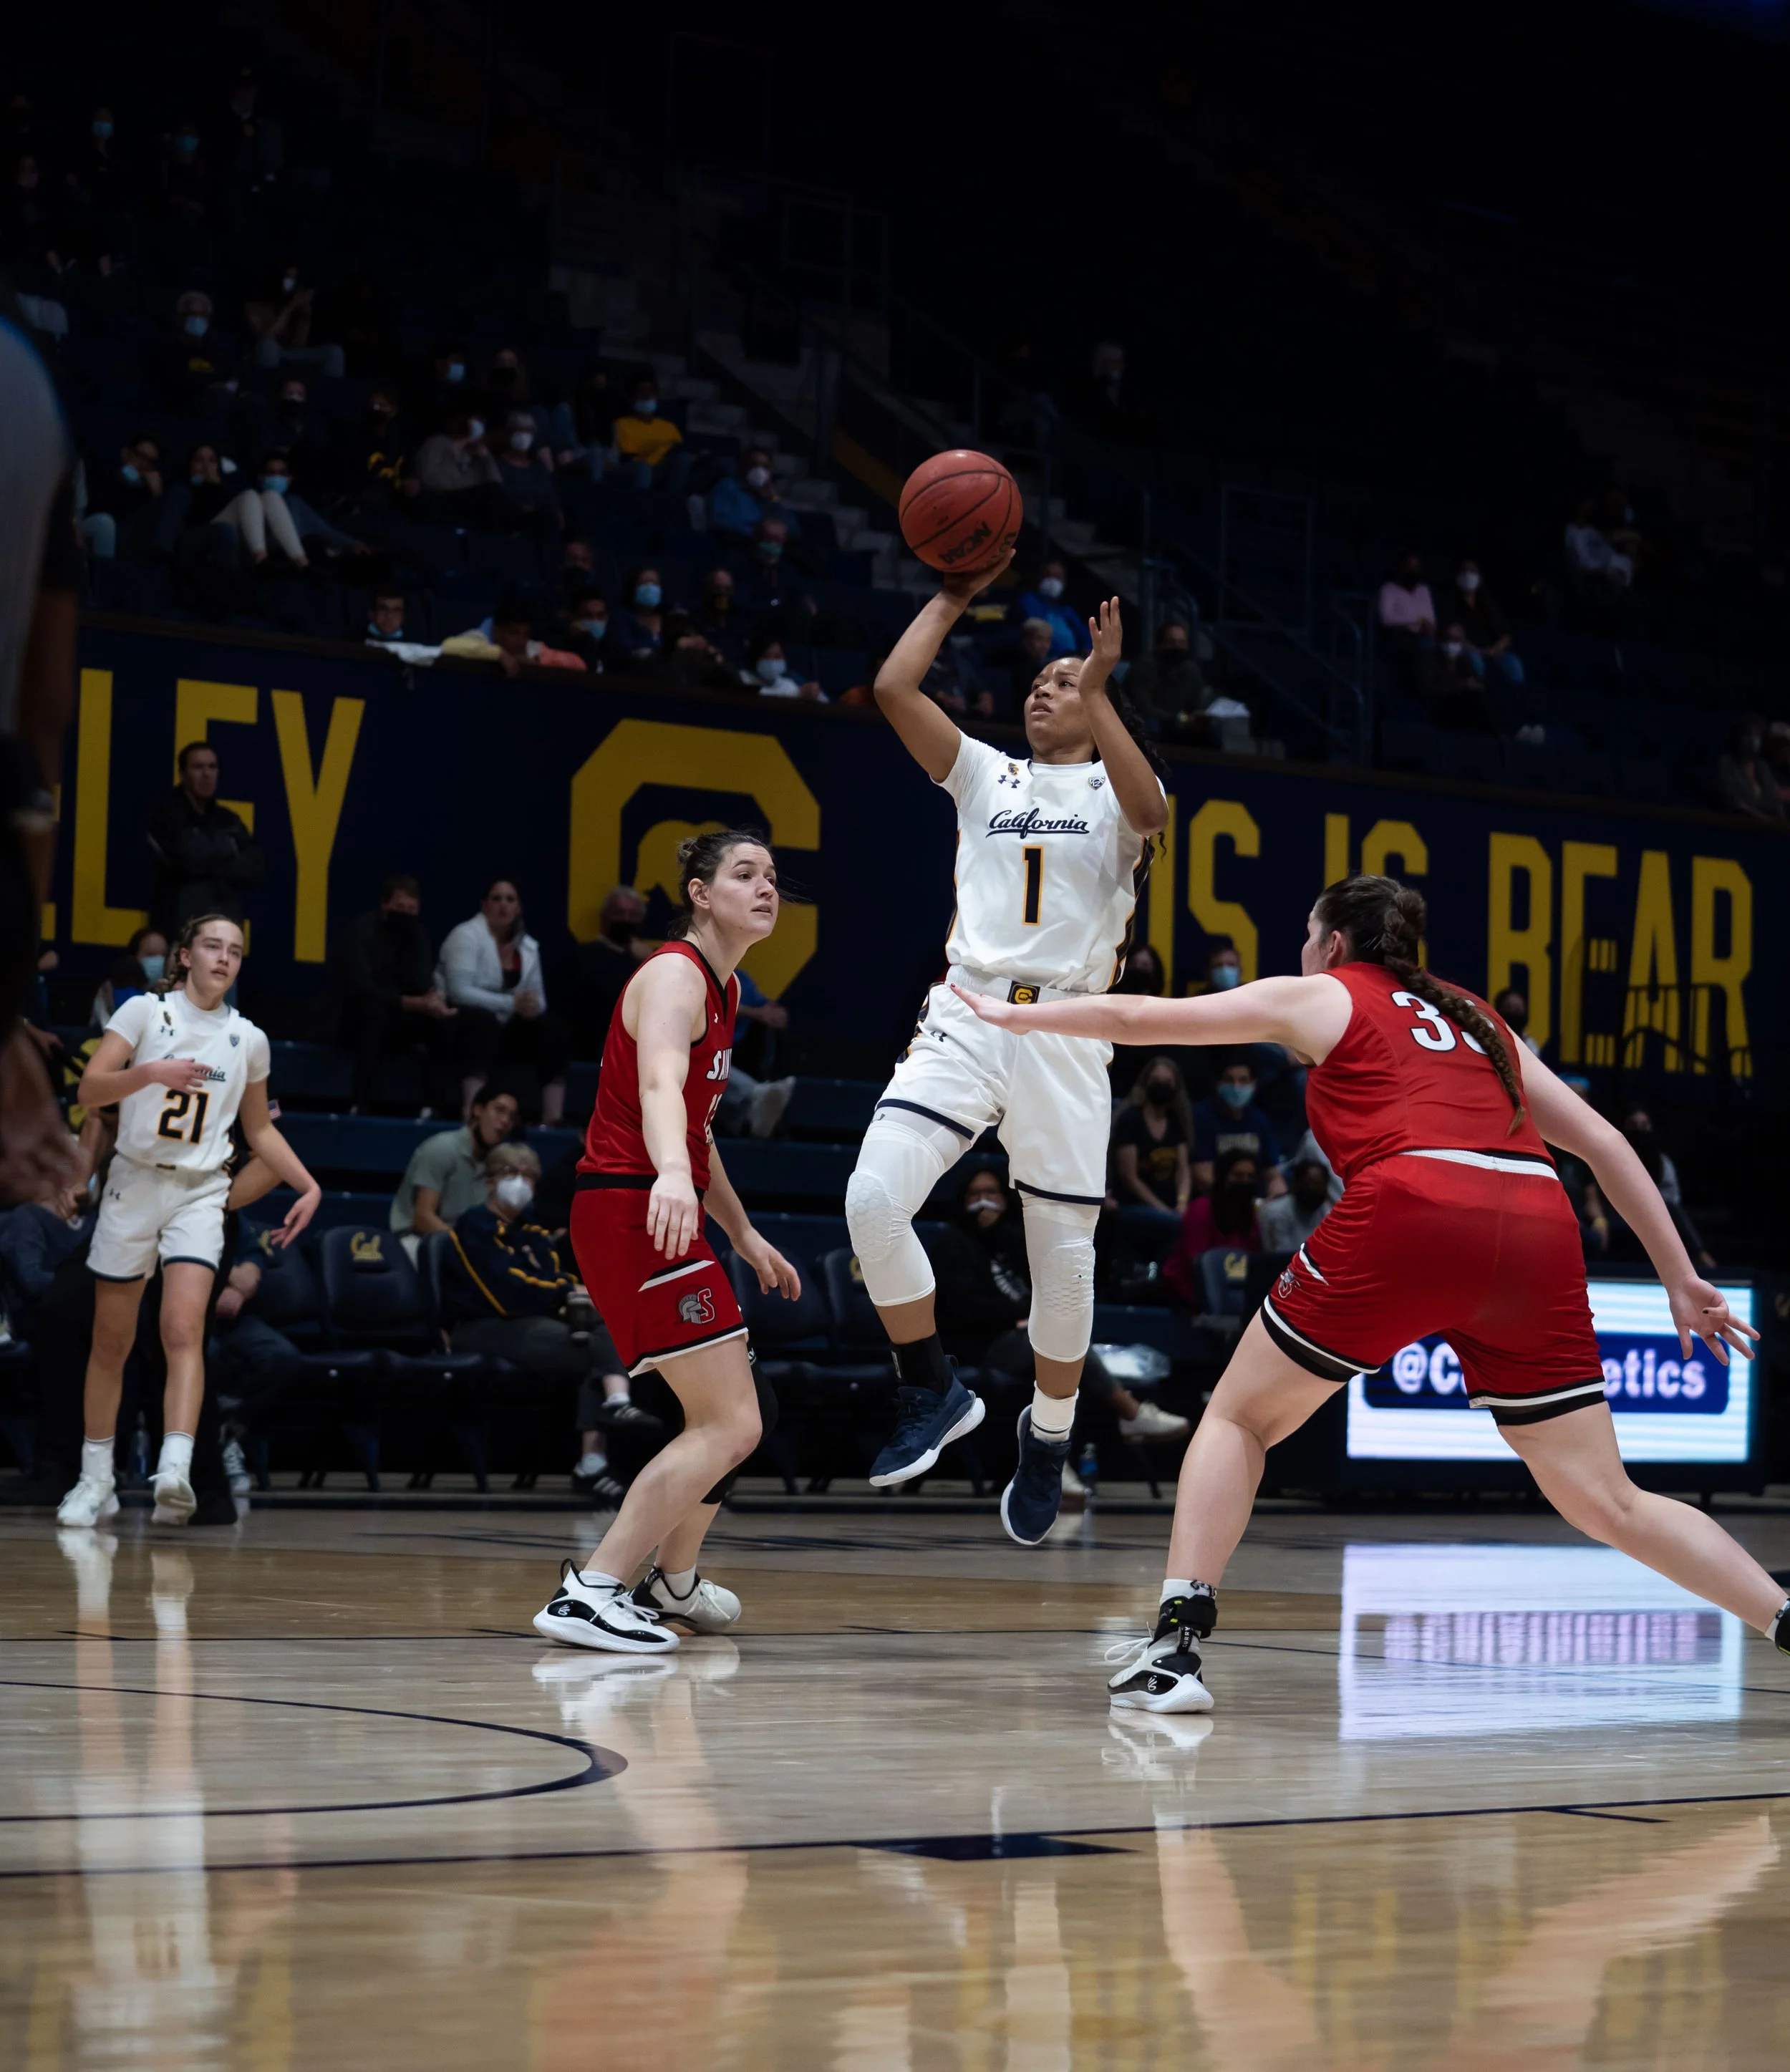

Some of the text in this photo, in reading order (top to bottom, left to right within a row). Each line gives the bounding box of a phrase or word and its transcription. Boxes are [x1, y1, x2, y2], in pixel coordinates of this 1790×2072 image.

[938, 521, 992, 565] NCAA
[985, 808, 1090, 839] California
[1022, 846, 1043, 926] 1
[1488, 831, 1753, 1078] BEAR
[158, 1088, 209, 1143] 21
[1392, 1341, 1707, 1400] @Cetics
[1182, 1626, 1191, 1647] CURRY
